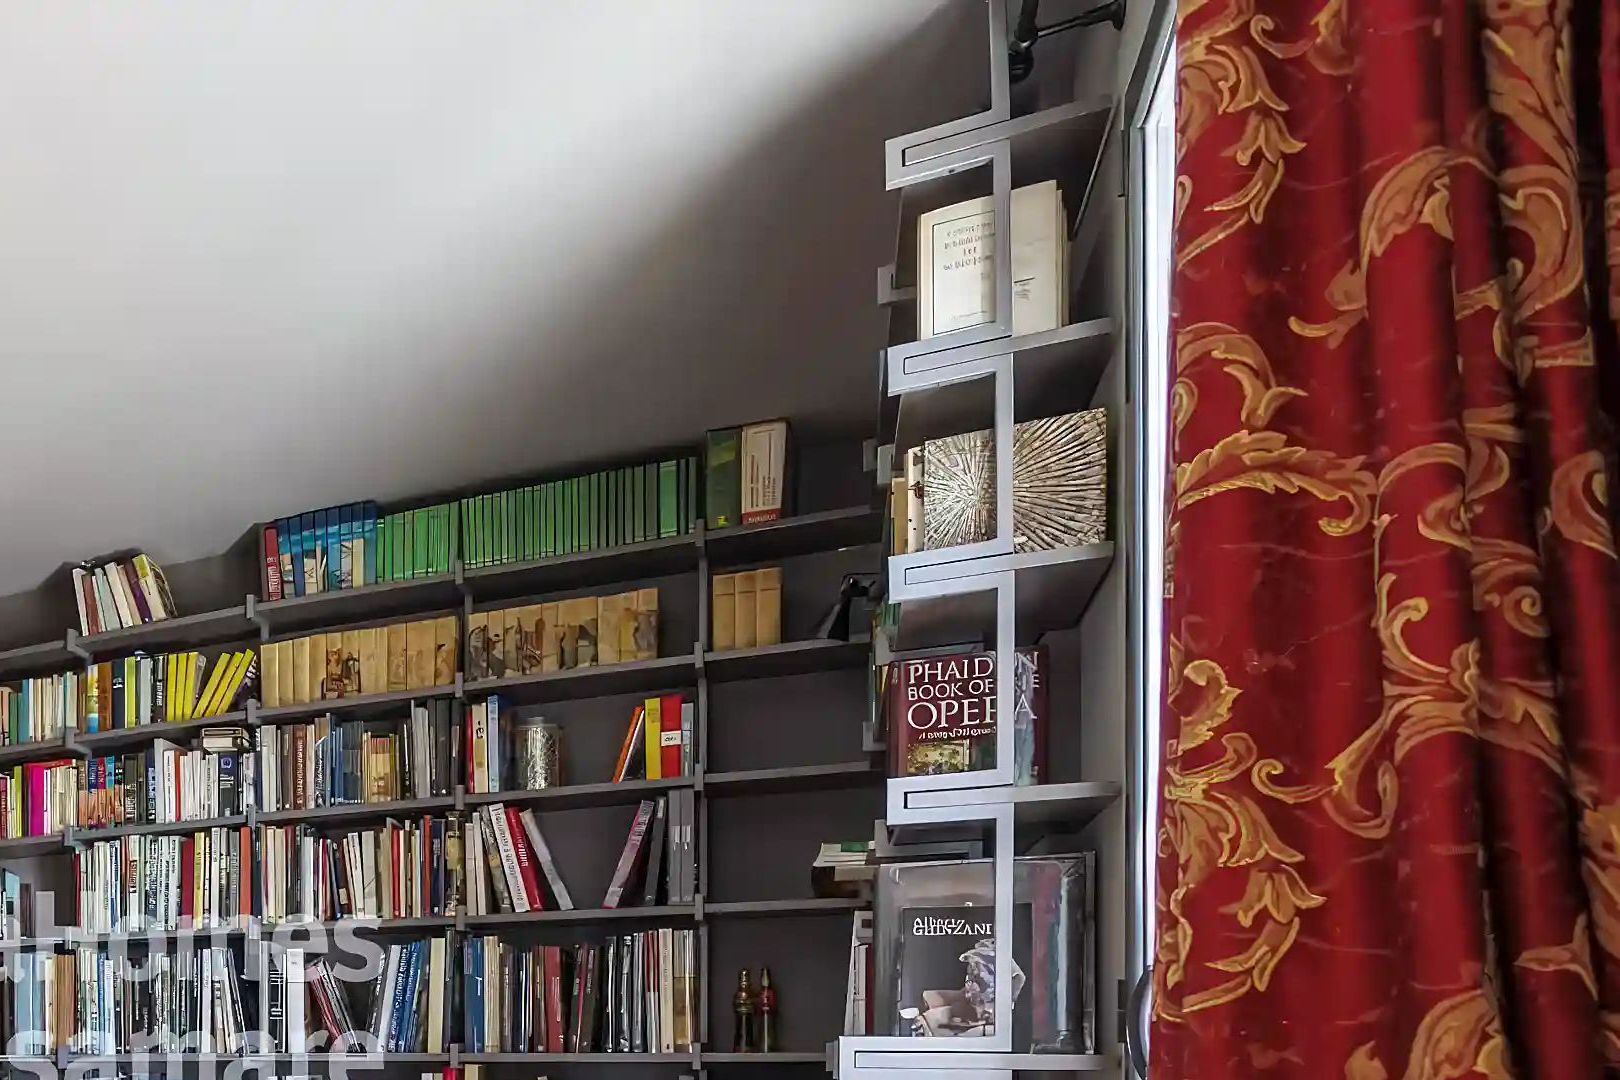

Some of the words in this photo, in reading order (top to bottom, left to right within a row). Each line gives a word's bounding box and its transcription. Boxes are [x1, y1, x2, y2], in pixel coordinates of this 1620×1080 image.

[908, 651, 1039, 685] PHAIDN
[908, 682, 964, 701] BOOK
[968, 678, 995, 695] OF
